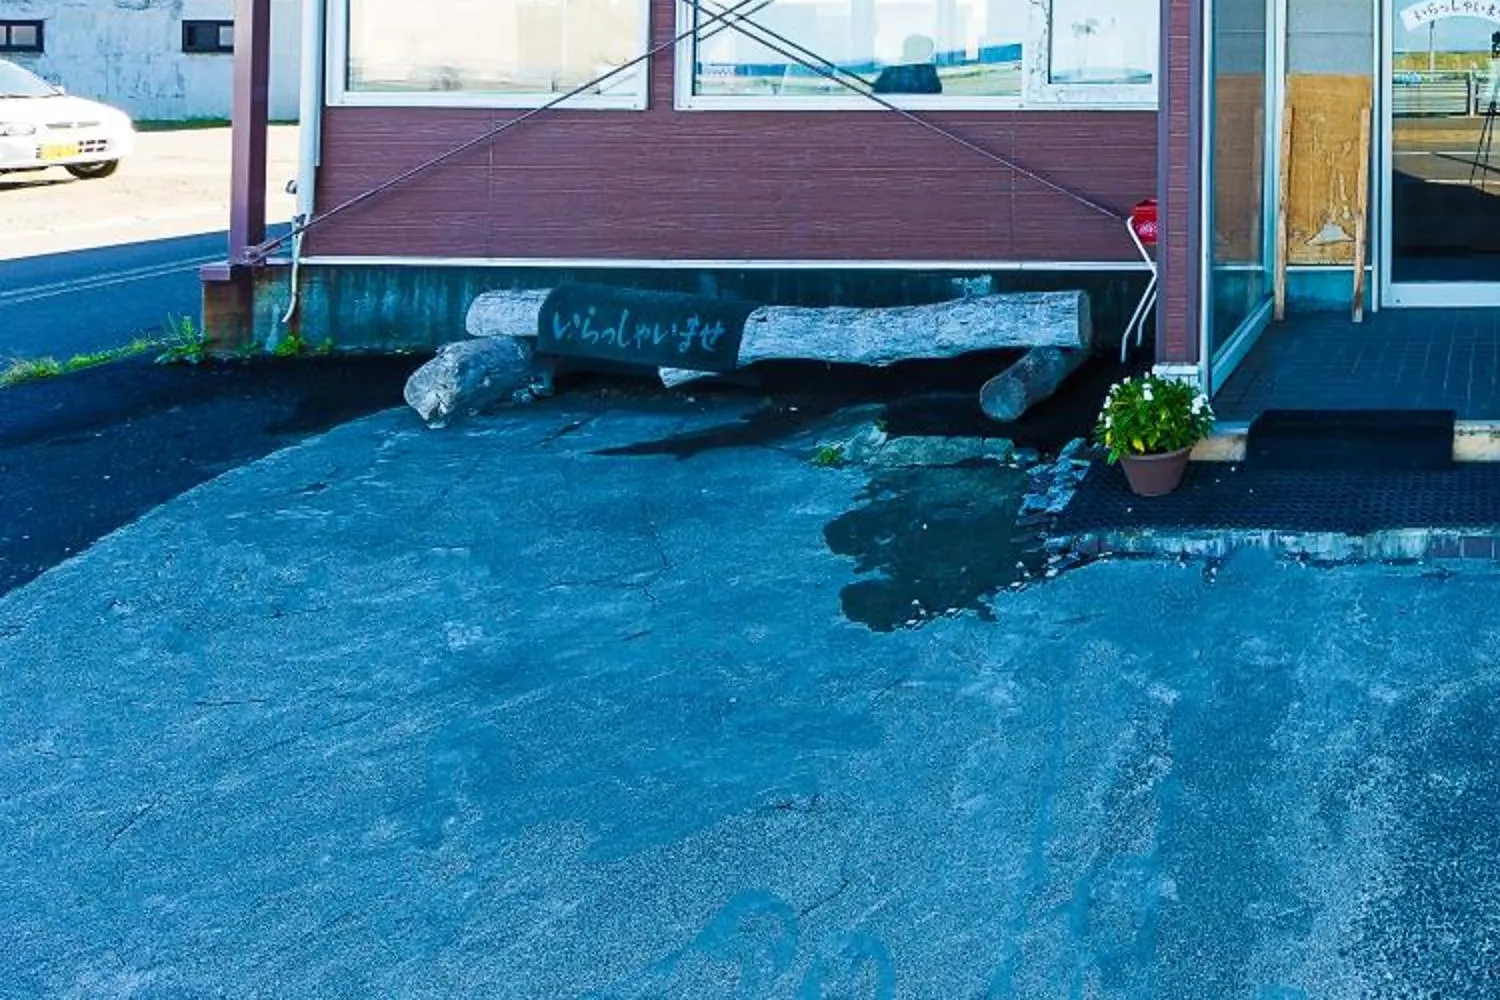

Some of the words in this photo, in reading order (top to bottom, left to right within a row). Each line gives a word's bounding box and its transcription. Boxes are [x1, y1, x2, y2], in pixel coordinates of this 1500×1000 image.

[552, 306, 726, 353] いらっしゃいませ
